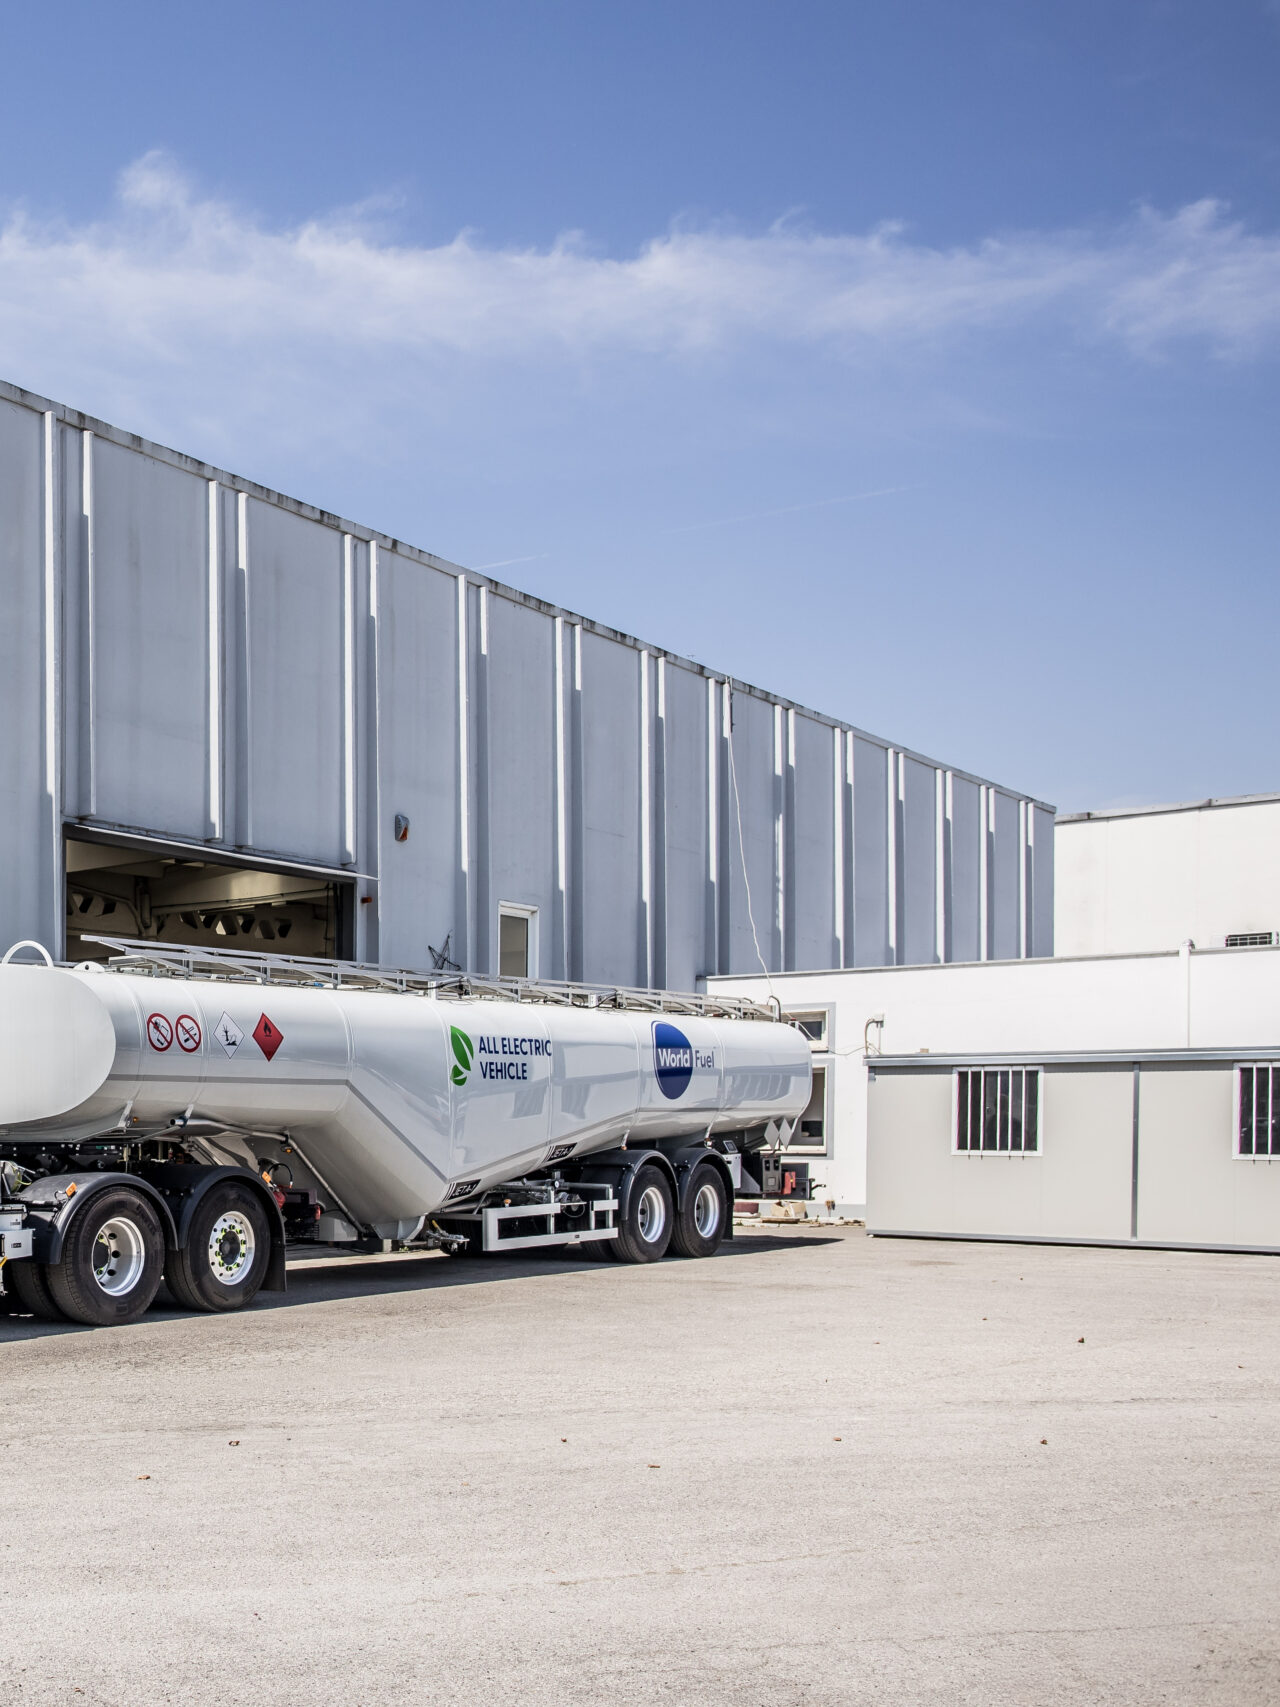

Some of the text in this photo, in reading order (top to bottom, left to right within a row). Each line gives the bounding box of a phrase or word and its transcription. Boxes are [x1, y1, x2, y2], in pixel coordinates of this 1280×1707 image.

[479, 1036, 552, 1056] ALL ELECTRIC
[658, 1048, 714, 1068] World Fuel
[480, 1061, 528, 1080] VEHICLE
